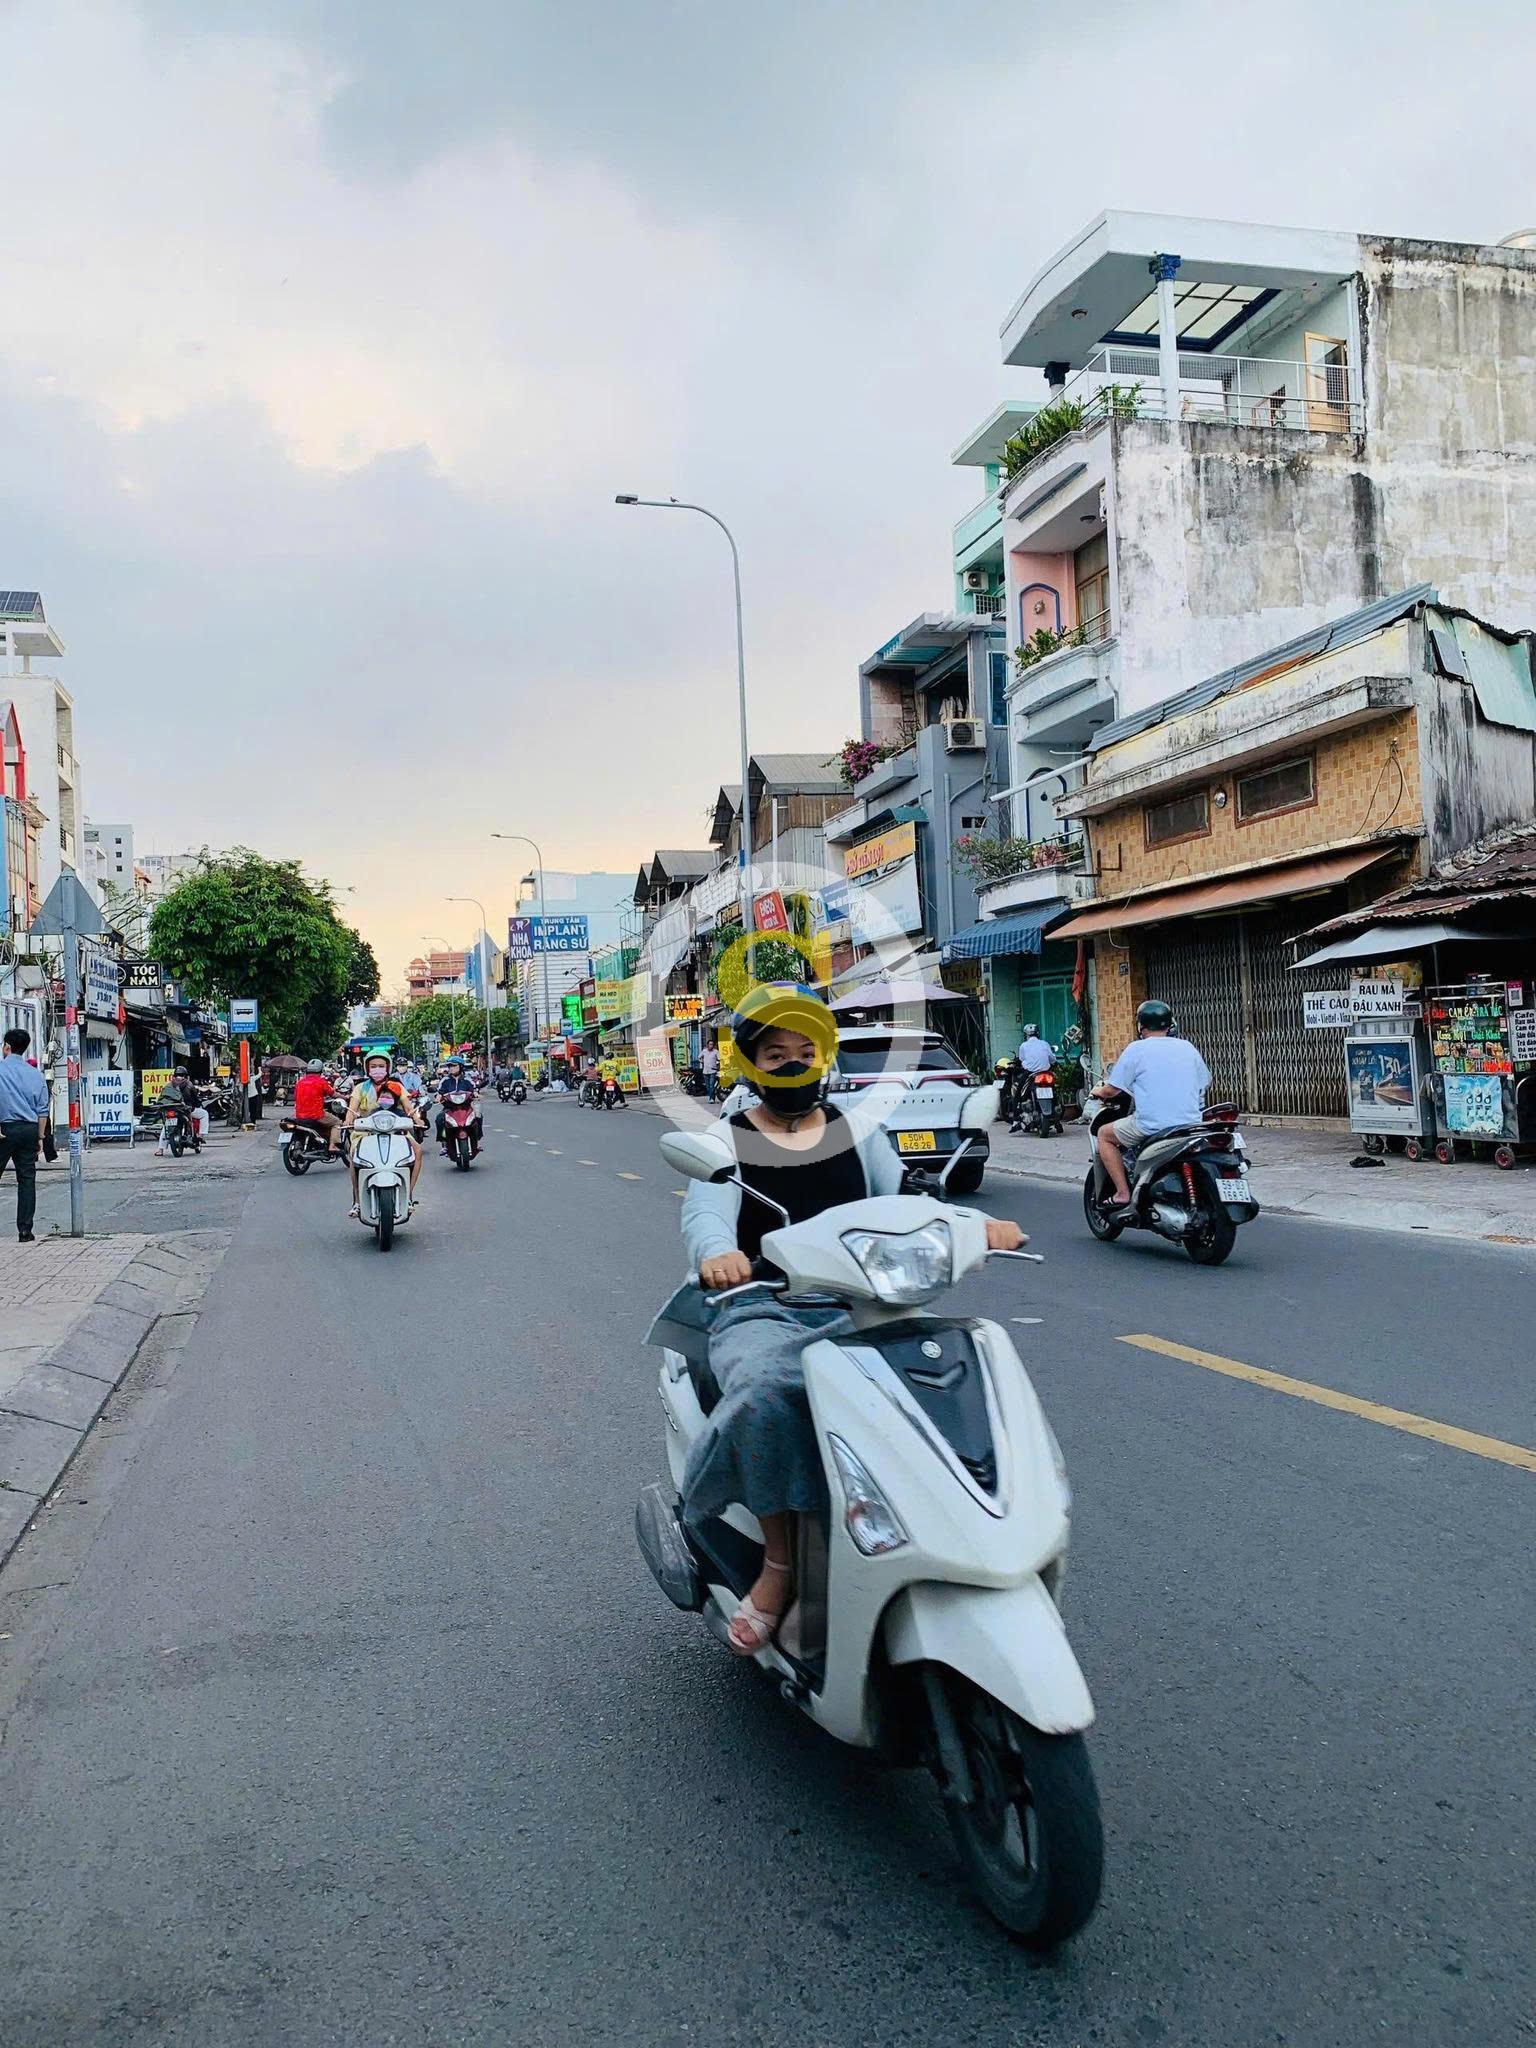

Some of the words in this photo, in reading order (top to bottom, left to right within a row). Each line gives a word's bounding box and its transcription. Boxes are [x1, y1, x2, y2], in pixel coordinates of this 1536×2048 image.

[534, 925, 586, 936] IMPLANT
[512, 932, 529, 946] NHA
[511, 946, 533, 959] KHOA
[132, 963, 156, 975] TÓC
[129, 976, 158, 986] NAM
[1360, 985, 1378, 994] RAU
[1306, 996, 1326, 1010] THẺ
[1329, 995, 1349, 1009] CÀO
[1353, 1000, 1373, 1013] ĐẬU
[1375, 1001, 1401, 1011] XANH
[646, 1058, 664, 1068] 50K
[92, 1090, 129, 1104] THUỐC
[99, 1110, 122, 1122] TÂY
